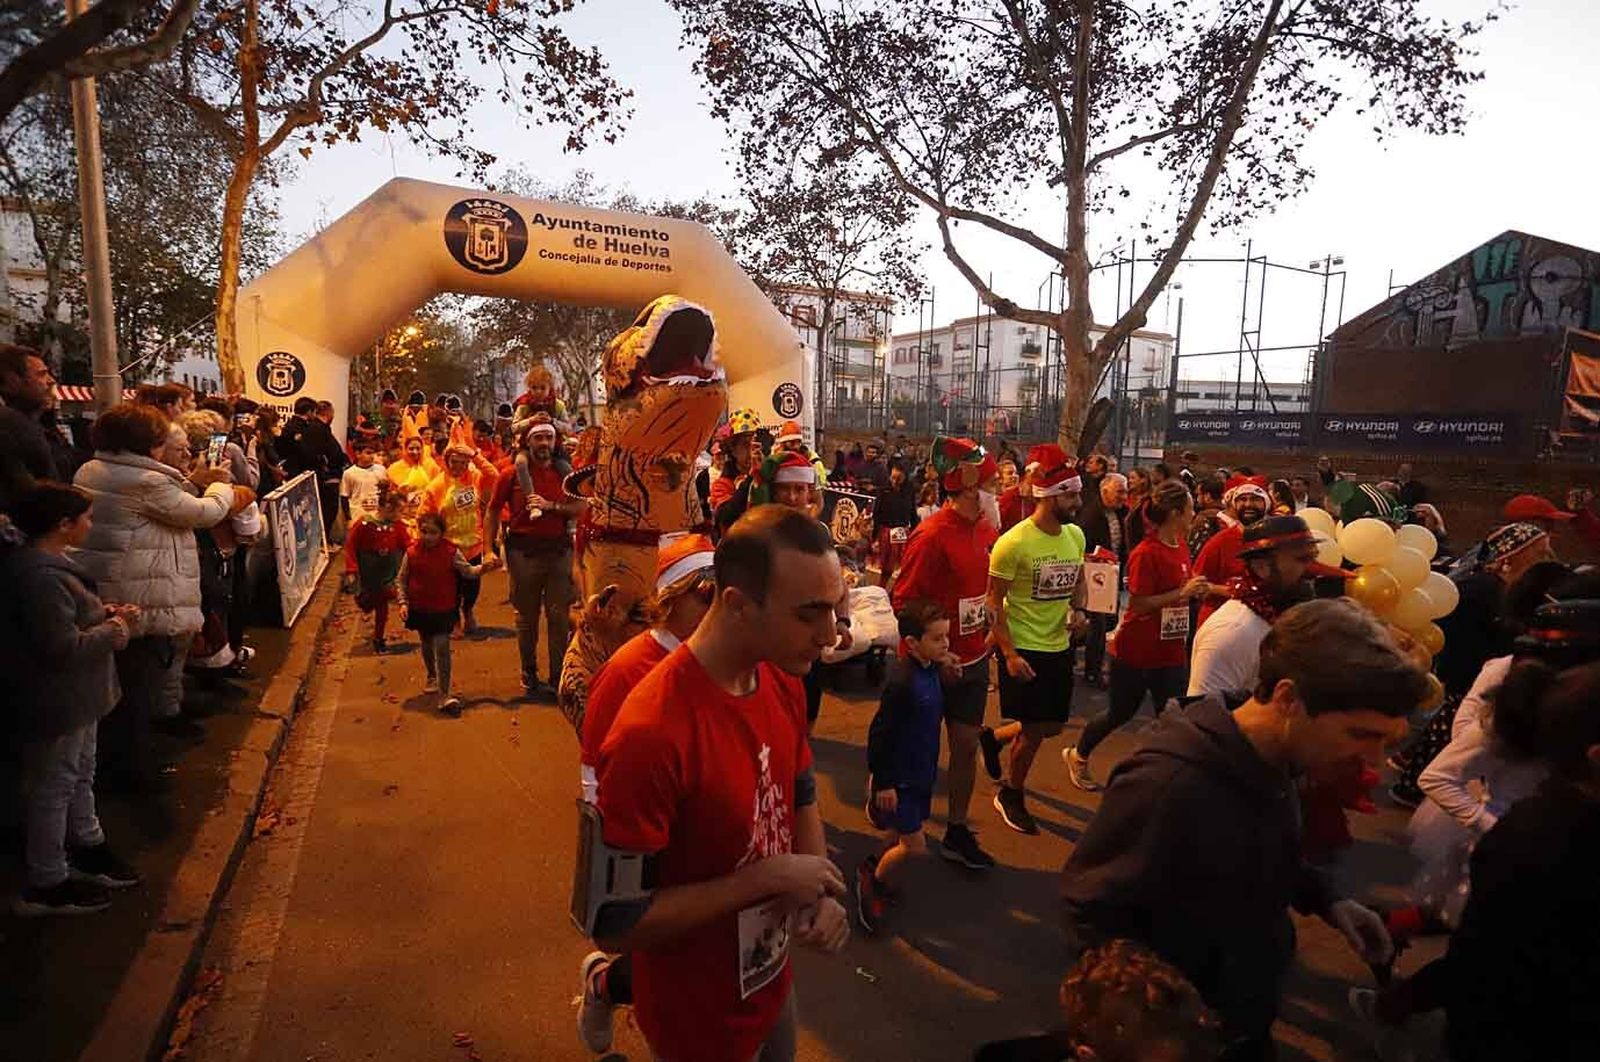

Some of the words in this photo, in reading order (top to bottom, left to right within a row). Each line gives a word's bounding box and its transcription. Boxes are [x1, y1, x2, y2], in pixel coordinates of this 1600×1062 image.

[532, 213, 670, 242] Ayuntamiento
[573, 234, 597, 249] de
[604, 237, 670, 258] Huelva
[604, 256, 618, 267] de
[622, 259, 672, 273] Deportes
[1192, 421, 1230, 430] HYUNDAI
[1257, 421, 1301, 430] HYUNDAI
[1346, 421, 1399, 431] HYUNDAI
[1439, 421, 1504, 432] HYUNDAI
[1056, 573, 1075, 587] 239
